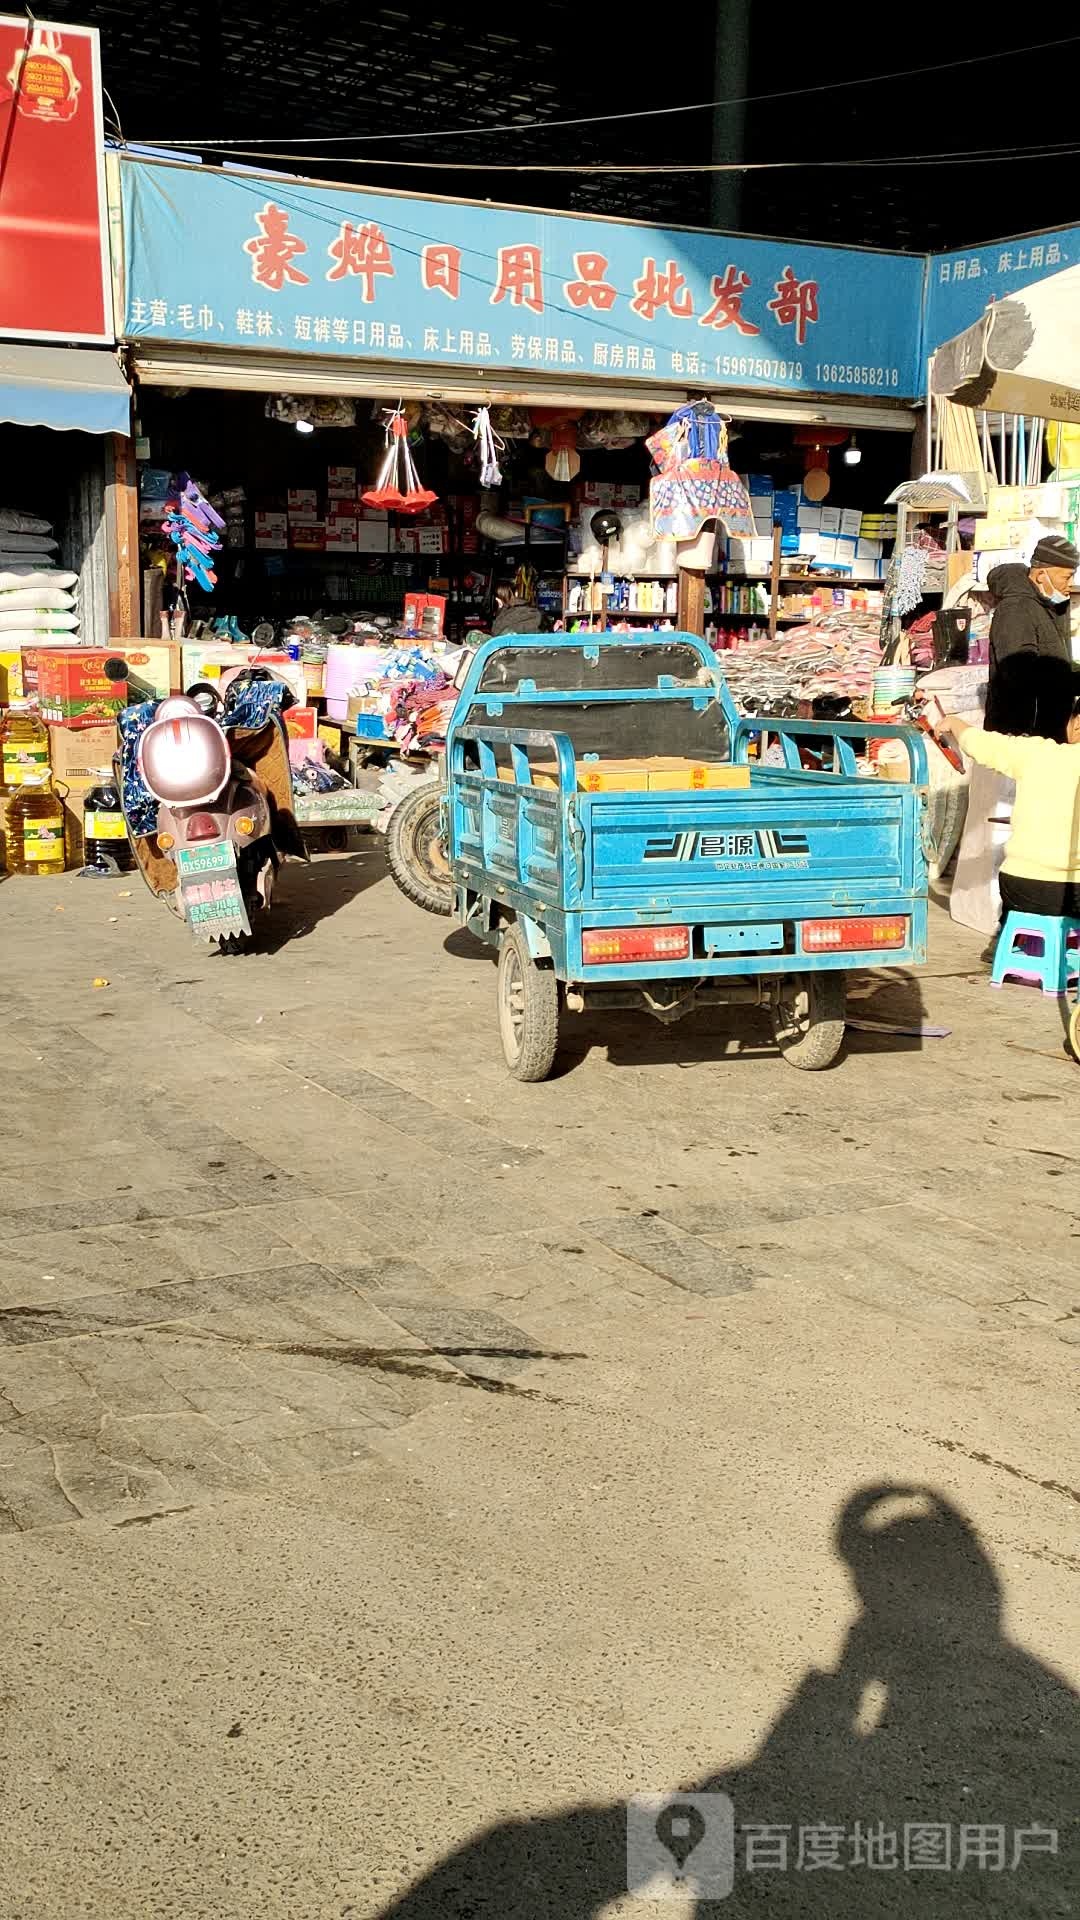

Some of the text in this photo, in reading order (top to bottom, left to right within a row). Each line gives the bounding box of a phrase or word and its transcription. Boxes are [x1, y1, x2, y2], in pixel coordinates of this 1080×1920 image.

[244, 202, 819, 344] 豪烨日用品批发部
[816, 363, 899, 387] 13625858218
[700, 834, 755, 858] 昌源
